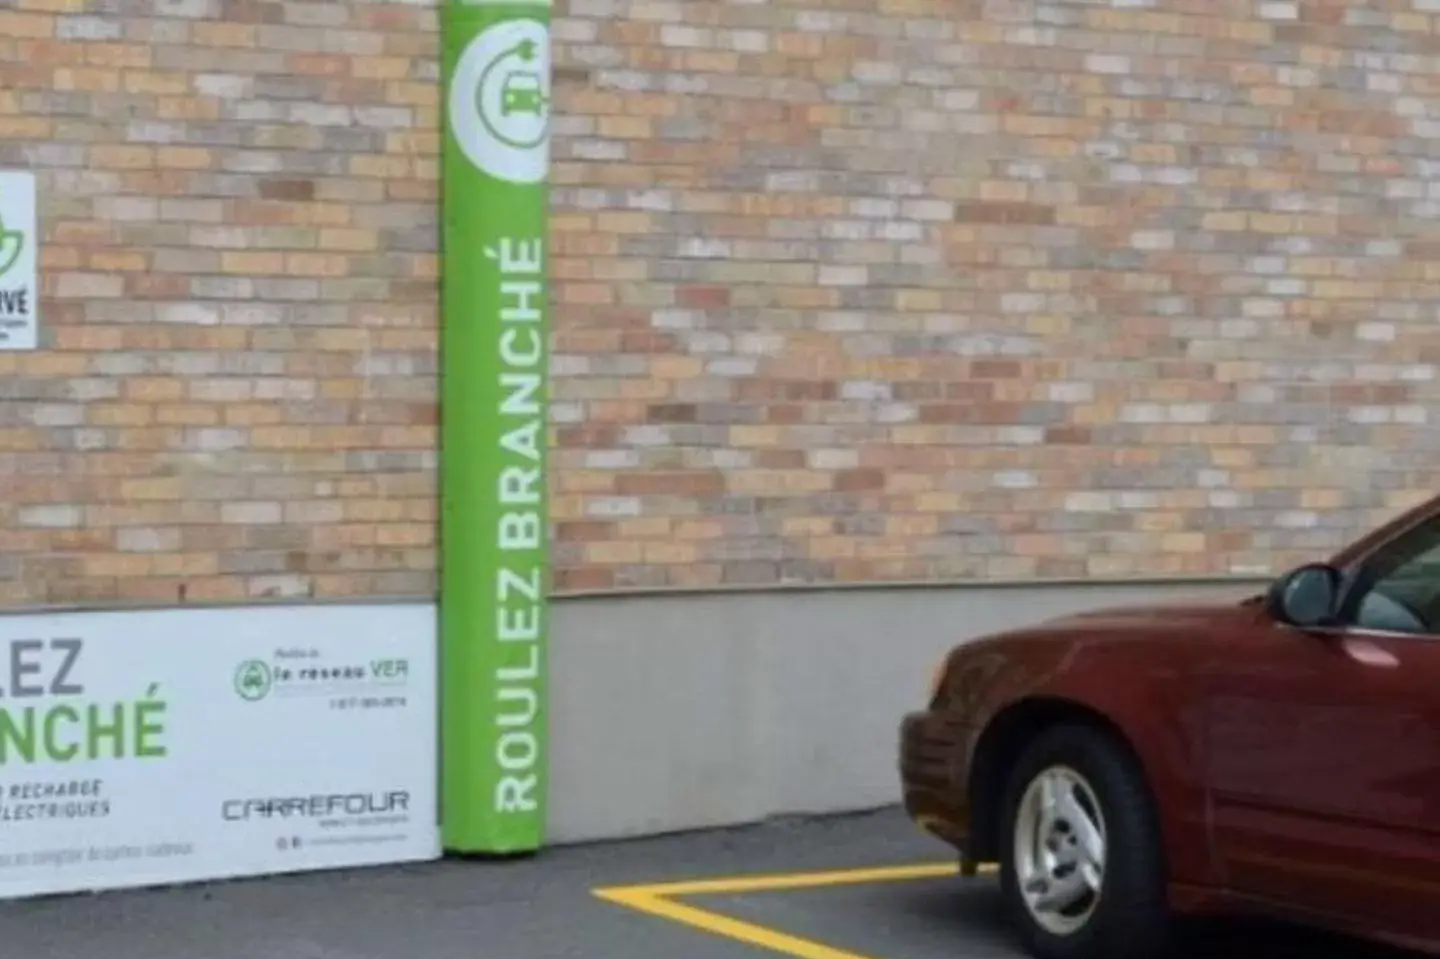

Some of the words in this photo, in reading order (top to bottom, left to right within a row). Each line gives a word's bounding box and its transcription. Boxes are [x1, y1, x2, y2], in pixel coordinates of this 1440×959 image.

[483, 237, 543, 550] BRANCHÉ
[369, 659, 409, 678] VER
[493, 566, 541, 814] ROULEZ
[222, 791, 411, 822] CARREFOUR
